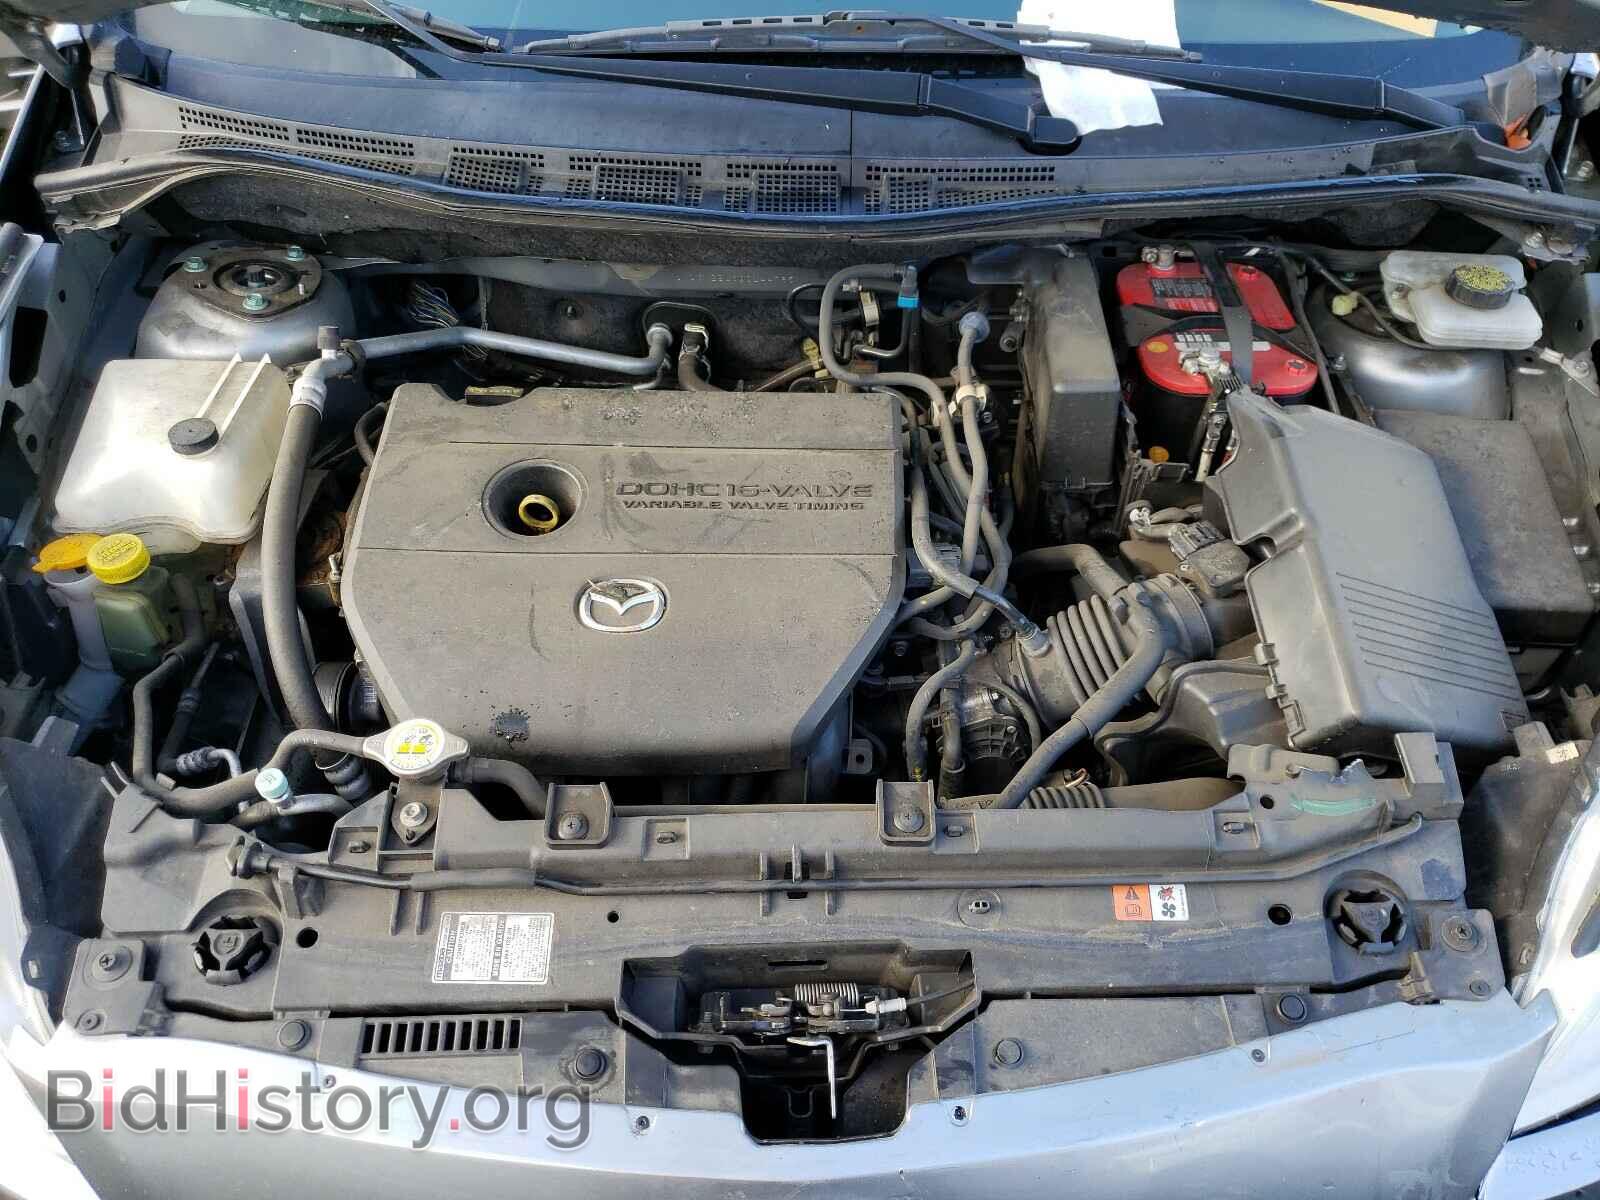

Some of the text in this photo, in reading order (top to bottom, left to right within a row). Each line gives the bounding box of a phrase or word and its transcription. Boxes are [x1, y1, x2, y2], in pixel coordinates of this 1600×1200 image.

[616, 482, 873, 498] DOHC 16-VALVE
[623, 500, 865, 511] VARIABLE VALVE TIMING
[446, 929, 458, 964] CAUTION
[491, 919, 505, 977] MISE EN GARDE
[436, 947, 447, 979] mazda
